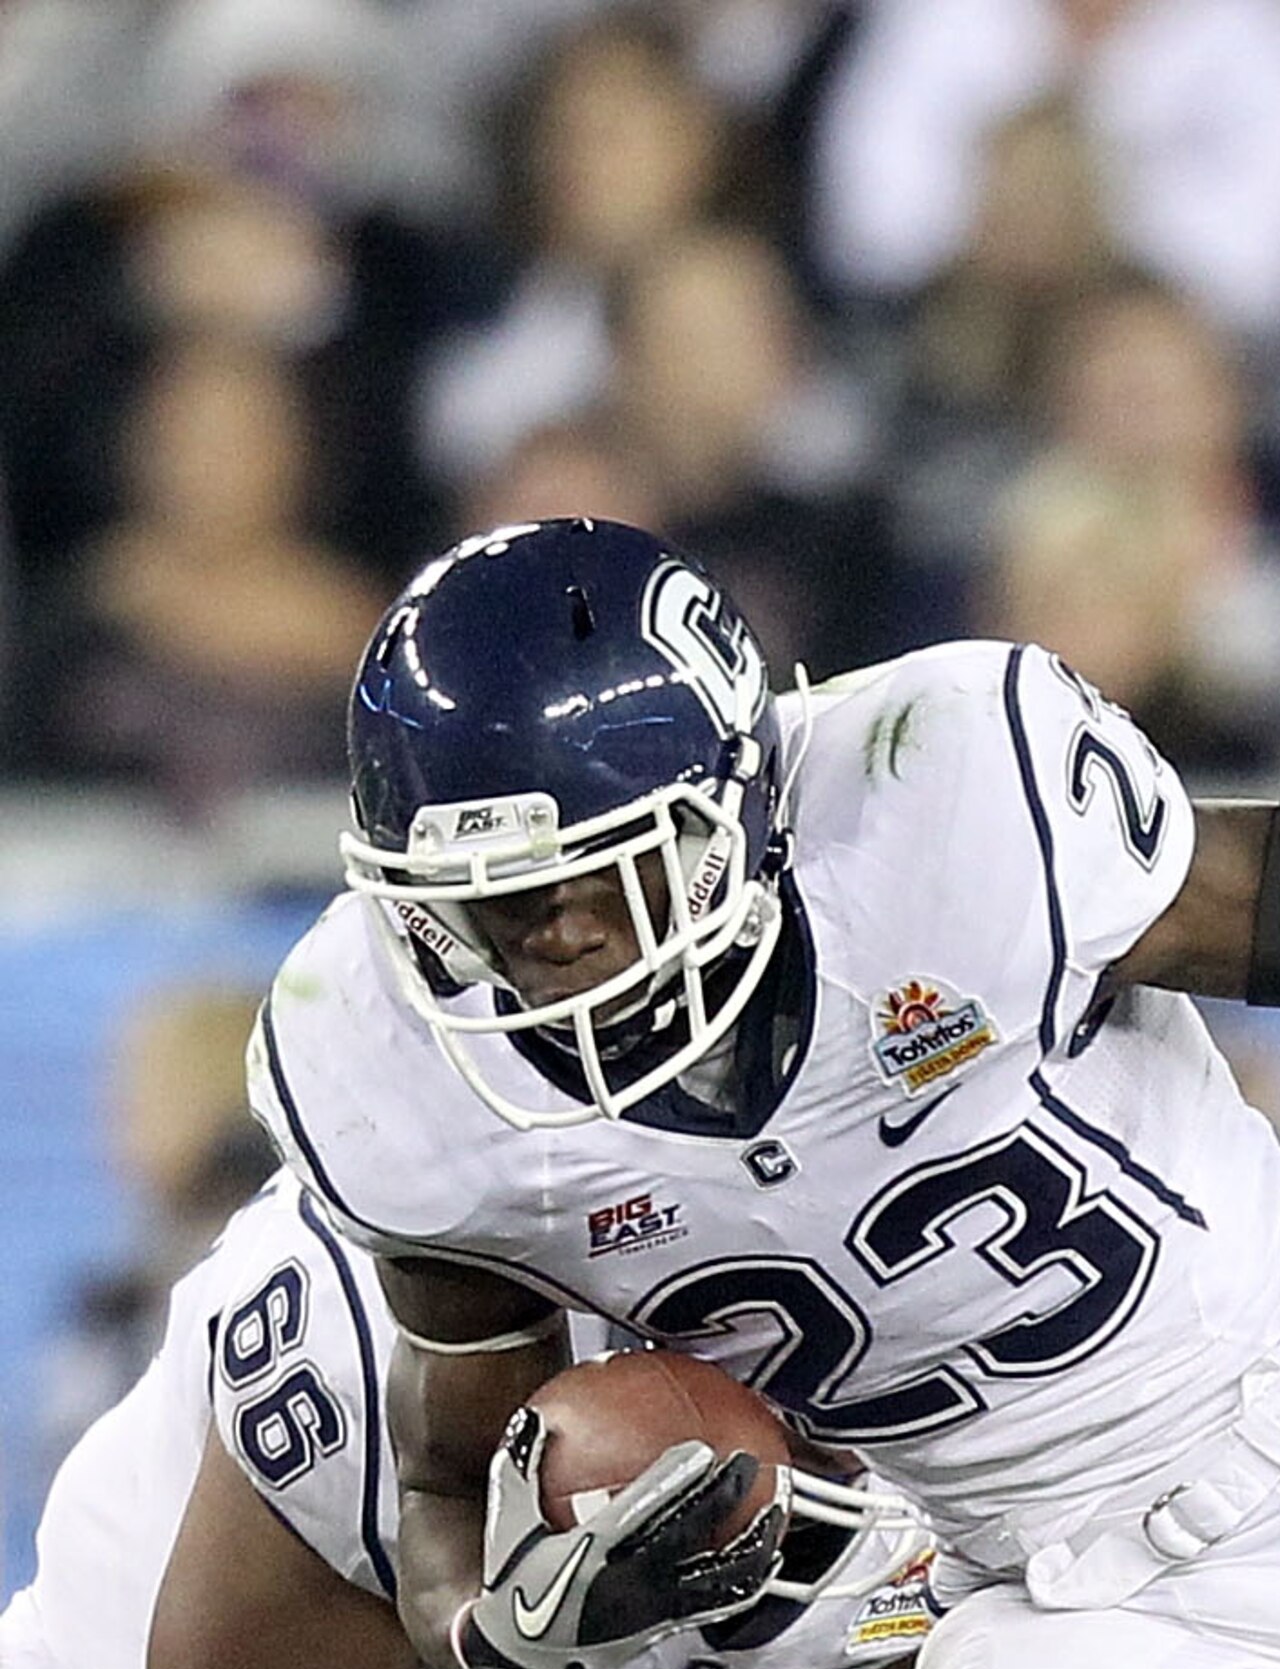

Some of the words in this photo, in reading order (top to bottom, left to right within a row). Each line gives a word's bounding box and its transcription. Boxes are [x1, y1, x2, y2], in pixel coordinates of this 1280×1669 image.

[1049, 653, 1171, 874] 2
[882, 1013, 976, 1067] Tostitos
[588, 1192, 653, 1234] BIG
[590, 1203, 681, 1249] EAST
[630, 1119, 1162, 1446] 23
[219, 1255, 348, 1491] 66
